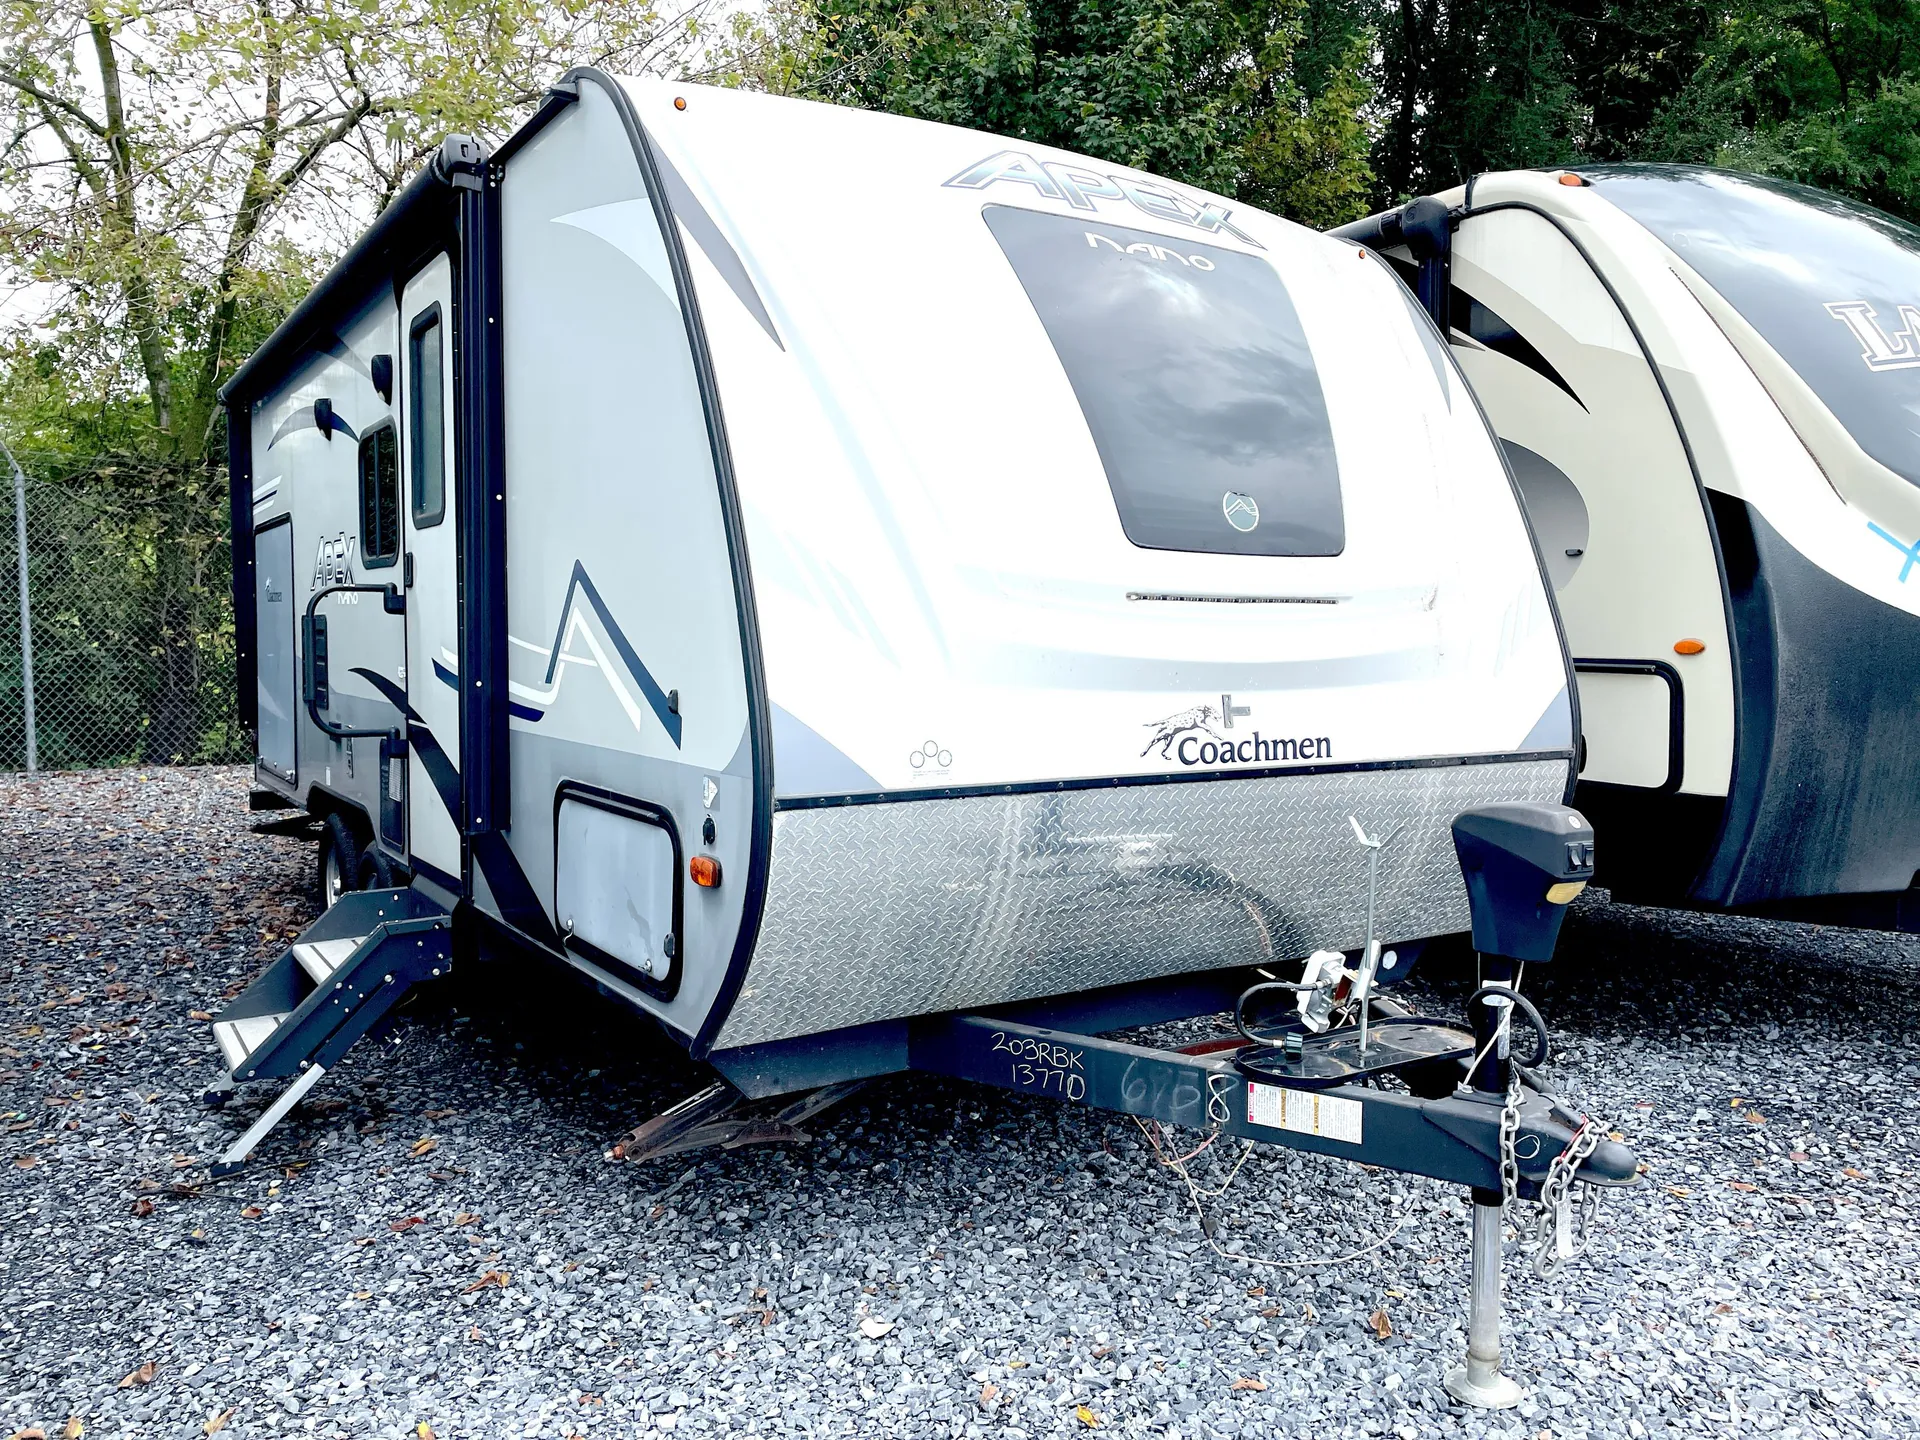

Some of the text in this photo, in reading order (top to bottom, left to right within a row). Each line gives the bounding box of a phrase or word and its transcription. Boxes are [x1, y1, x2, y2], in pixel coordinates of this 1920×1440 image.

[941, 150, 1267, 251] APEX
[310, 531, 356, 591] APEX
[1178, 731, 1332, 766] Coachmen
[991, 1032, 1085, 1071] 203RBK
